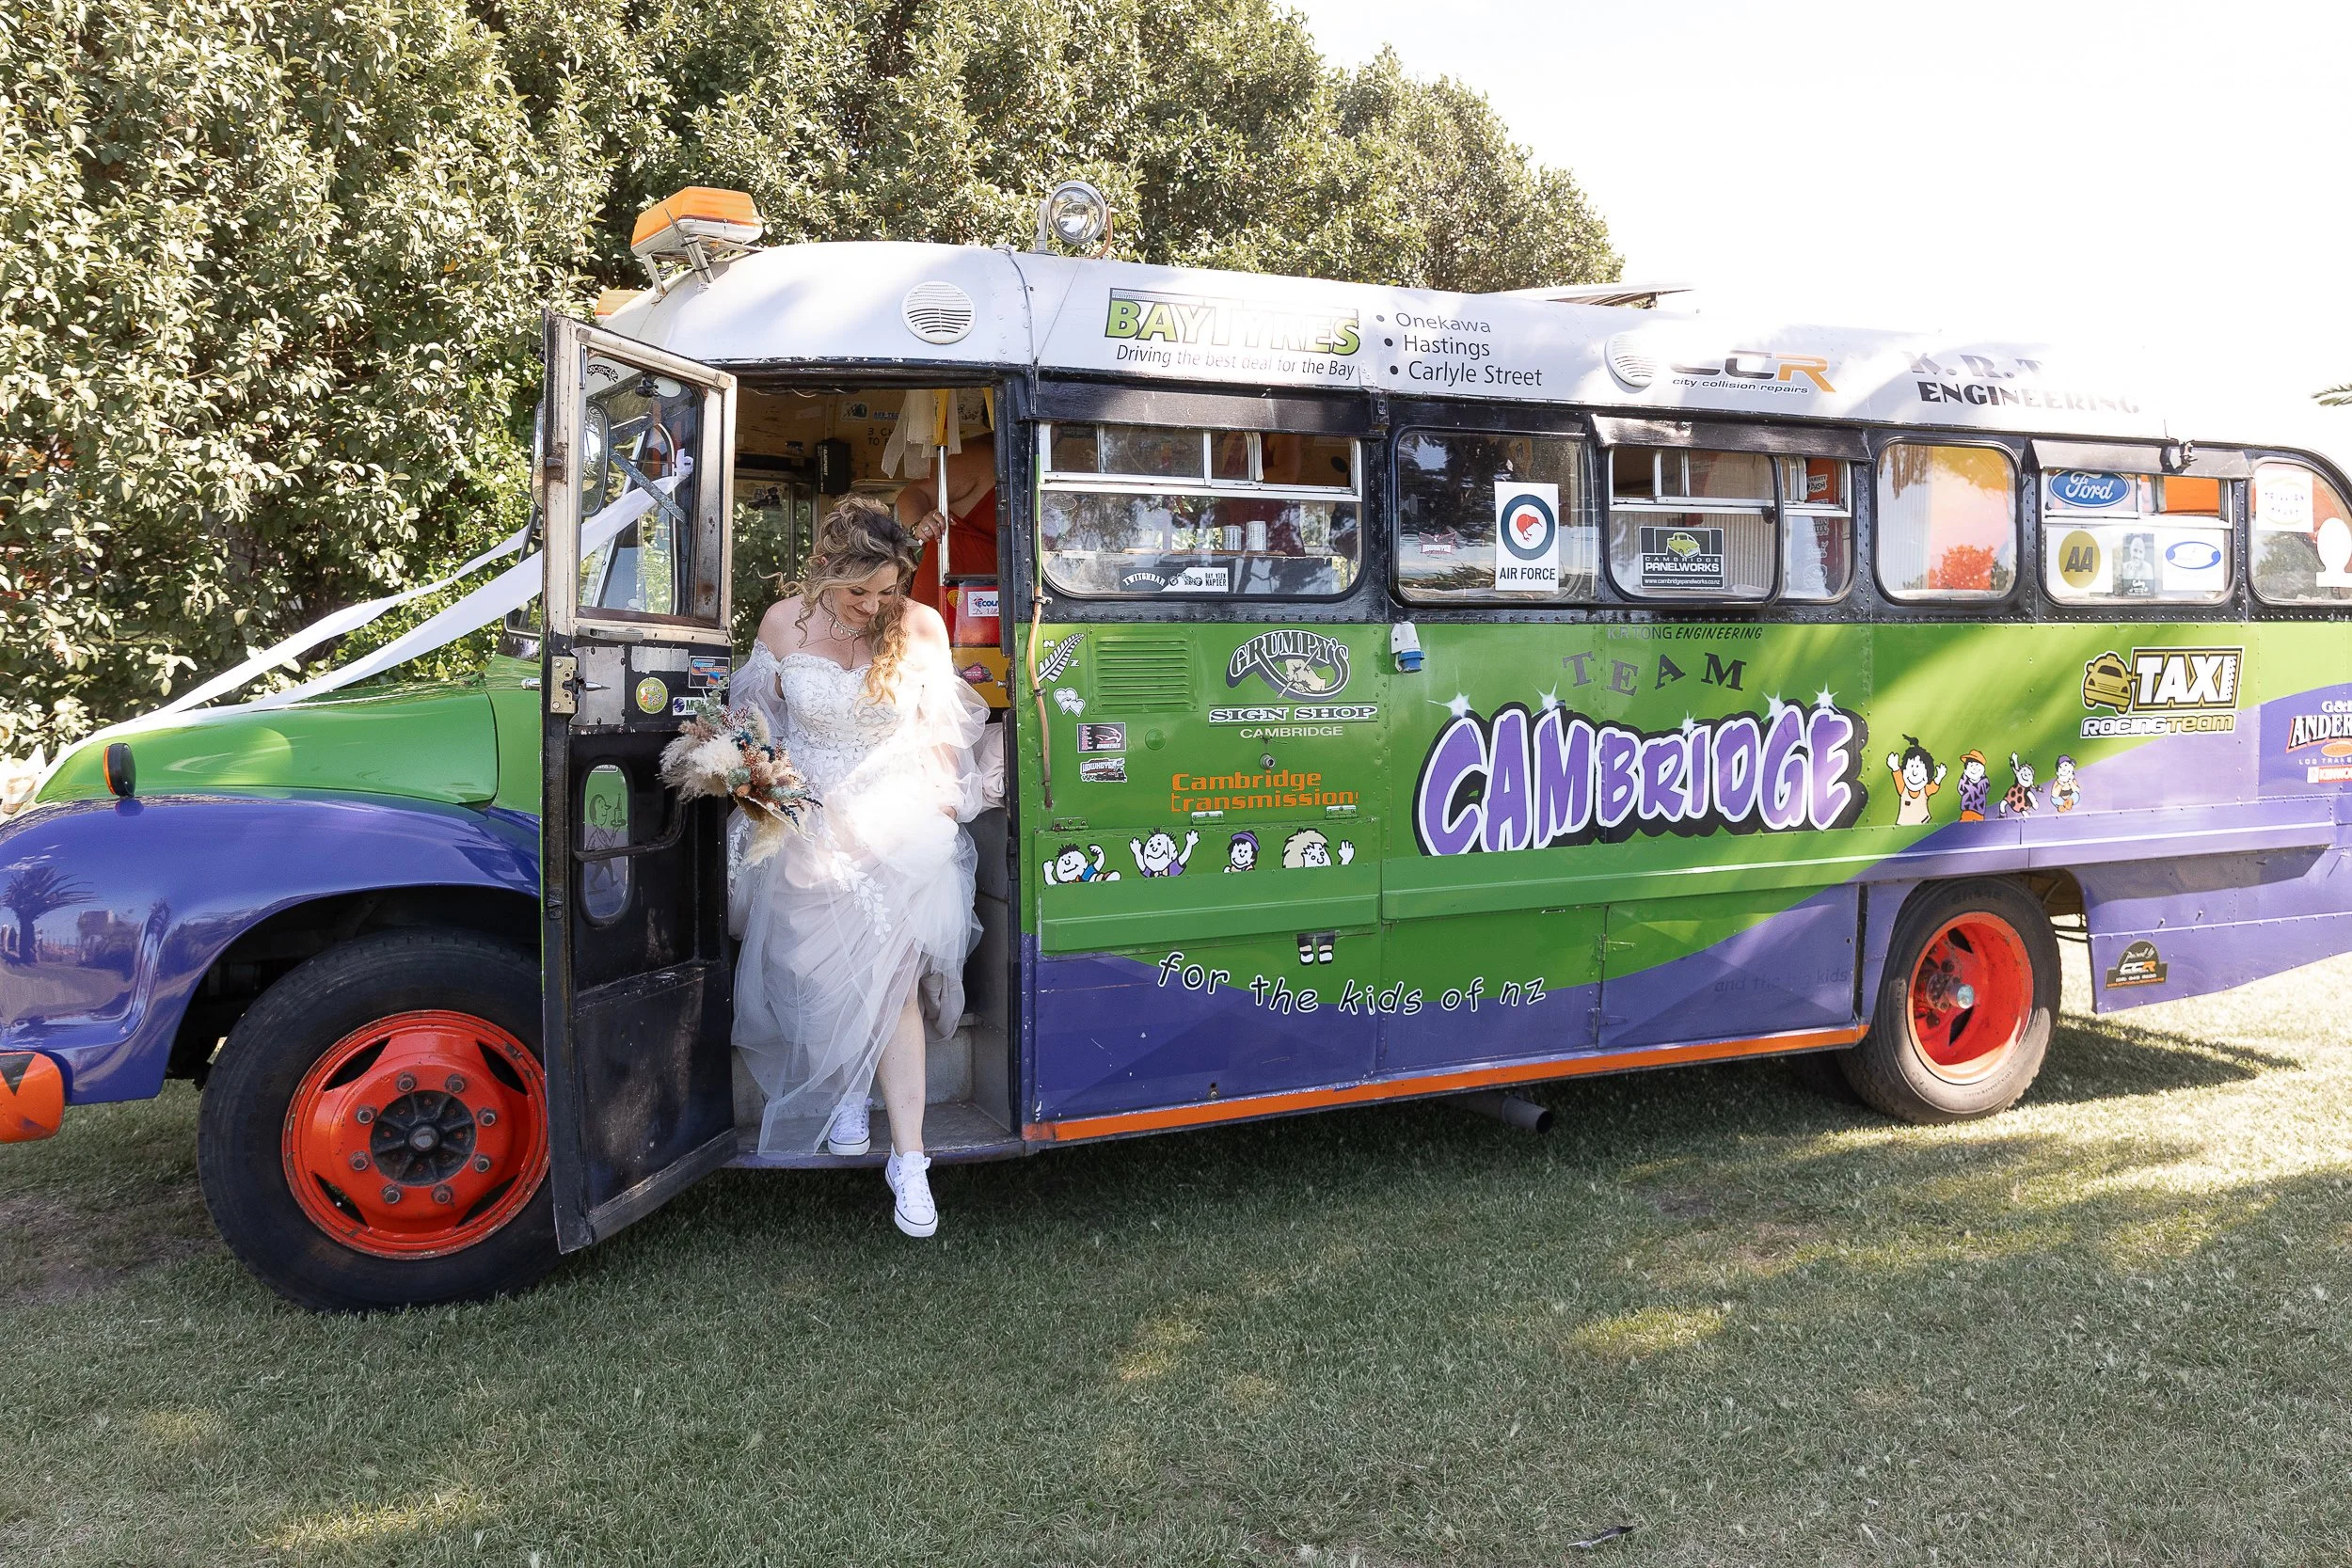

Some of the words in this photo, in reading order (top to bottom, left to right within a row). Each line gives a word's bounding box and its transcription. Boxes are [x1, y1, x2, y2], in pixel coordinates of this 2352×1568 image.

[1396, 312, 1491, 333] Onekawa
[1404, 335, 1490, 360] Hastings
[1117, 344, 1171, 368] Driving
[1177, 350, 1200, 366] the
[1205, 352, 1237, 369] best
[1241, 355, 1270, 371] deal
[1278, 357, 1297, 372] for
[1301, 357, 1325, 374] the
[1328, 360, 1355, 381] Bay
[1408, 361, 1477, 387] Carlyle
[1484, 365, 1542, 387] Street
[1673, 378, 1697, 388] city
[1702, 379, 1756, 390] collision
[1760, 385, 1808, 394] repairs
[1916, 381, 2140, 414] ENGINEERING
[2065, 470, 2114, 500] Ford
[1645, 562, 1720, 572] PANELWORKS
[2065, 546, 2094, 572] AA
[1499, 567, 1518, 580] AIR
[1520, 567, 1556, 580] FORCE
[1676, 627, 1763, 640] ENGINEERING
[1227, 628, 1351, 699] GRUMPY'S
[1563, 651, 1747, 696] TEAM
[2136, 657, 2237, 704] TAXI
[1209, 707, 1289, 722] SIGN
[1295, 705, 1378, 722] SHOP
[1240, 726, 1343, 738] CAMBRIDGE
[1171, 769, 1322, 792] Cambridge
[1417, 703, 1853, 856] CAMBRIDGE
[1157, 951, 1230, 995] for
[1249, 975, 1318, 1014] the
[1337, 979, 1422, 1015] kids
[1440, 976, 1484, 1012] of
[1500, 977, 1548, 1006] nz
[1714, 979, 1746, 992] and
[1817, 968, 1848, 985] kids
